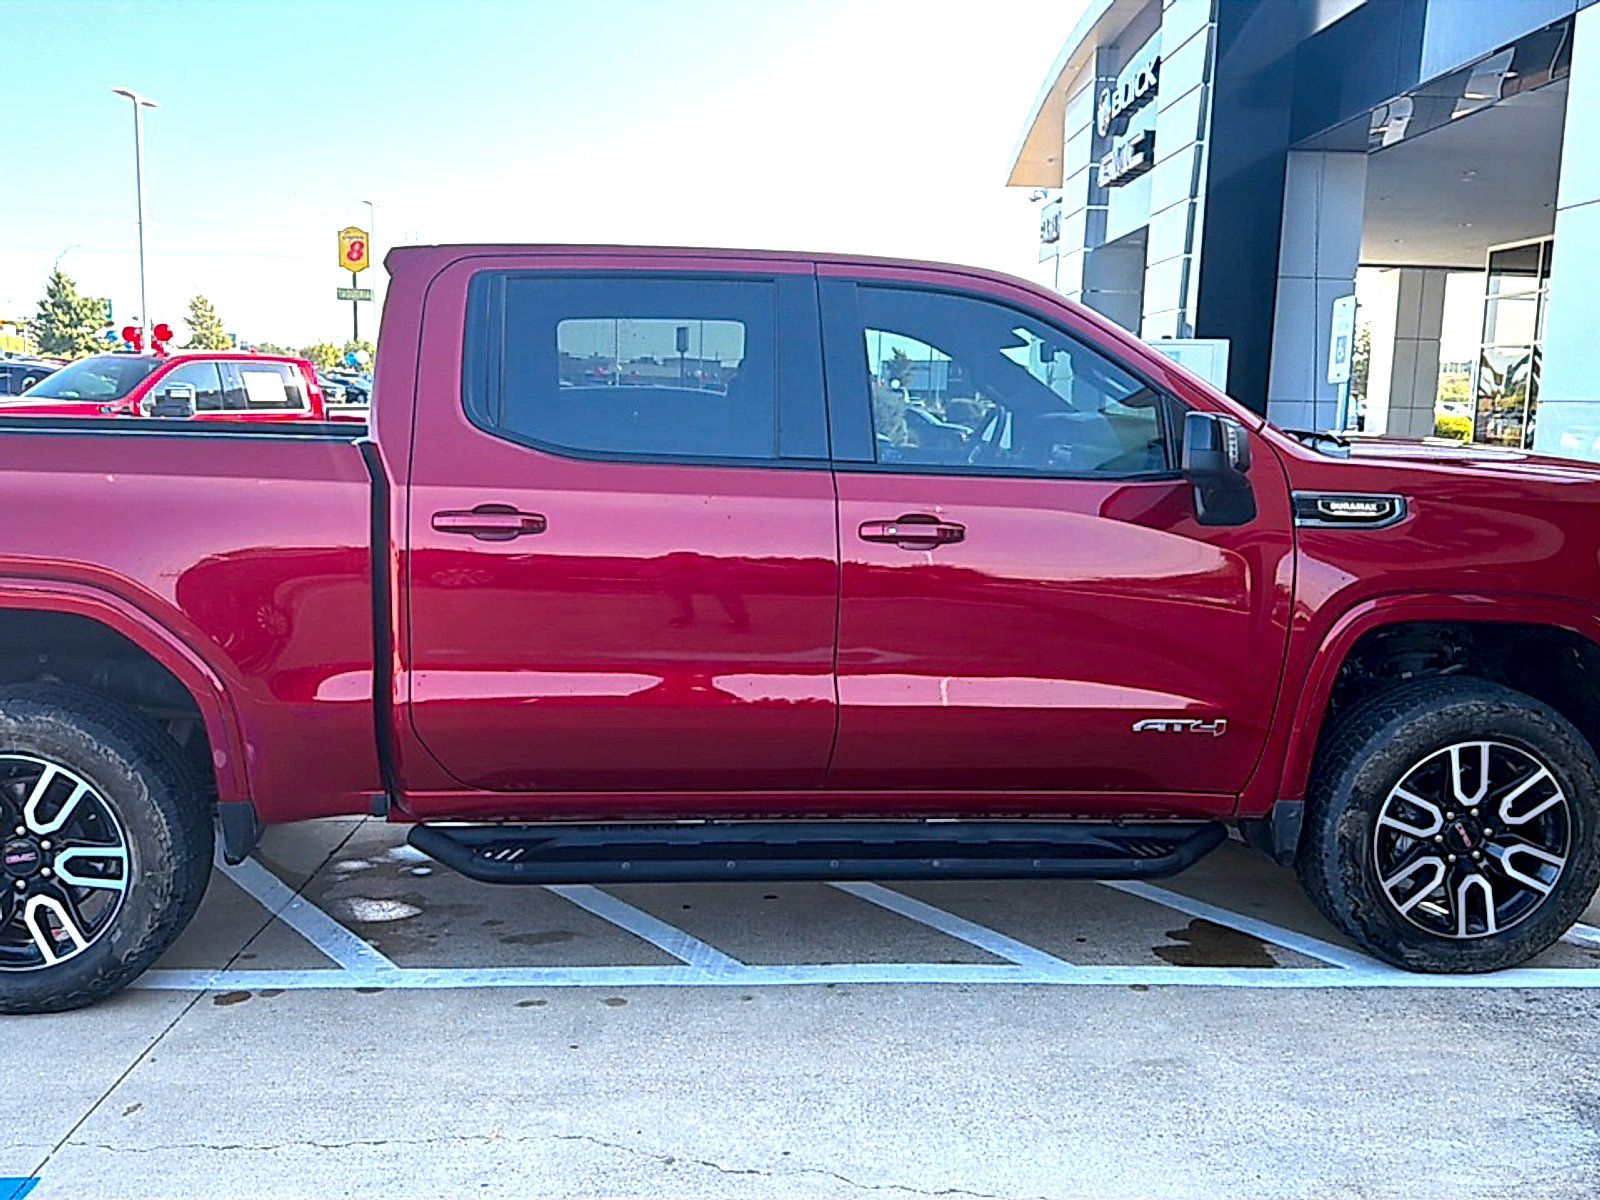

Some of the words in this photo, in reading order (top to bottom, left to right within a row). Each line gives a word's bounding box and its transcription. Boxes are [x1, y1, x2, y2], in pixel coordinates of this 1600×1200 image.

[1111, 57, 1159, 118] BUICK
[1097, 131, 1148, 187] GMC
[347, 240, 364, 261] 8
[1330, 501, 1378, 511] DURAMAX
[1132, 719, 1227, 736] AT4
[5, 852, 37, 864] GMC
